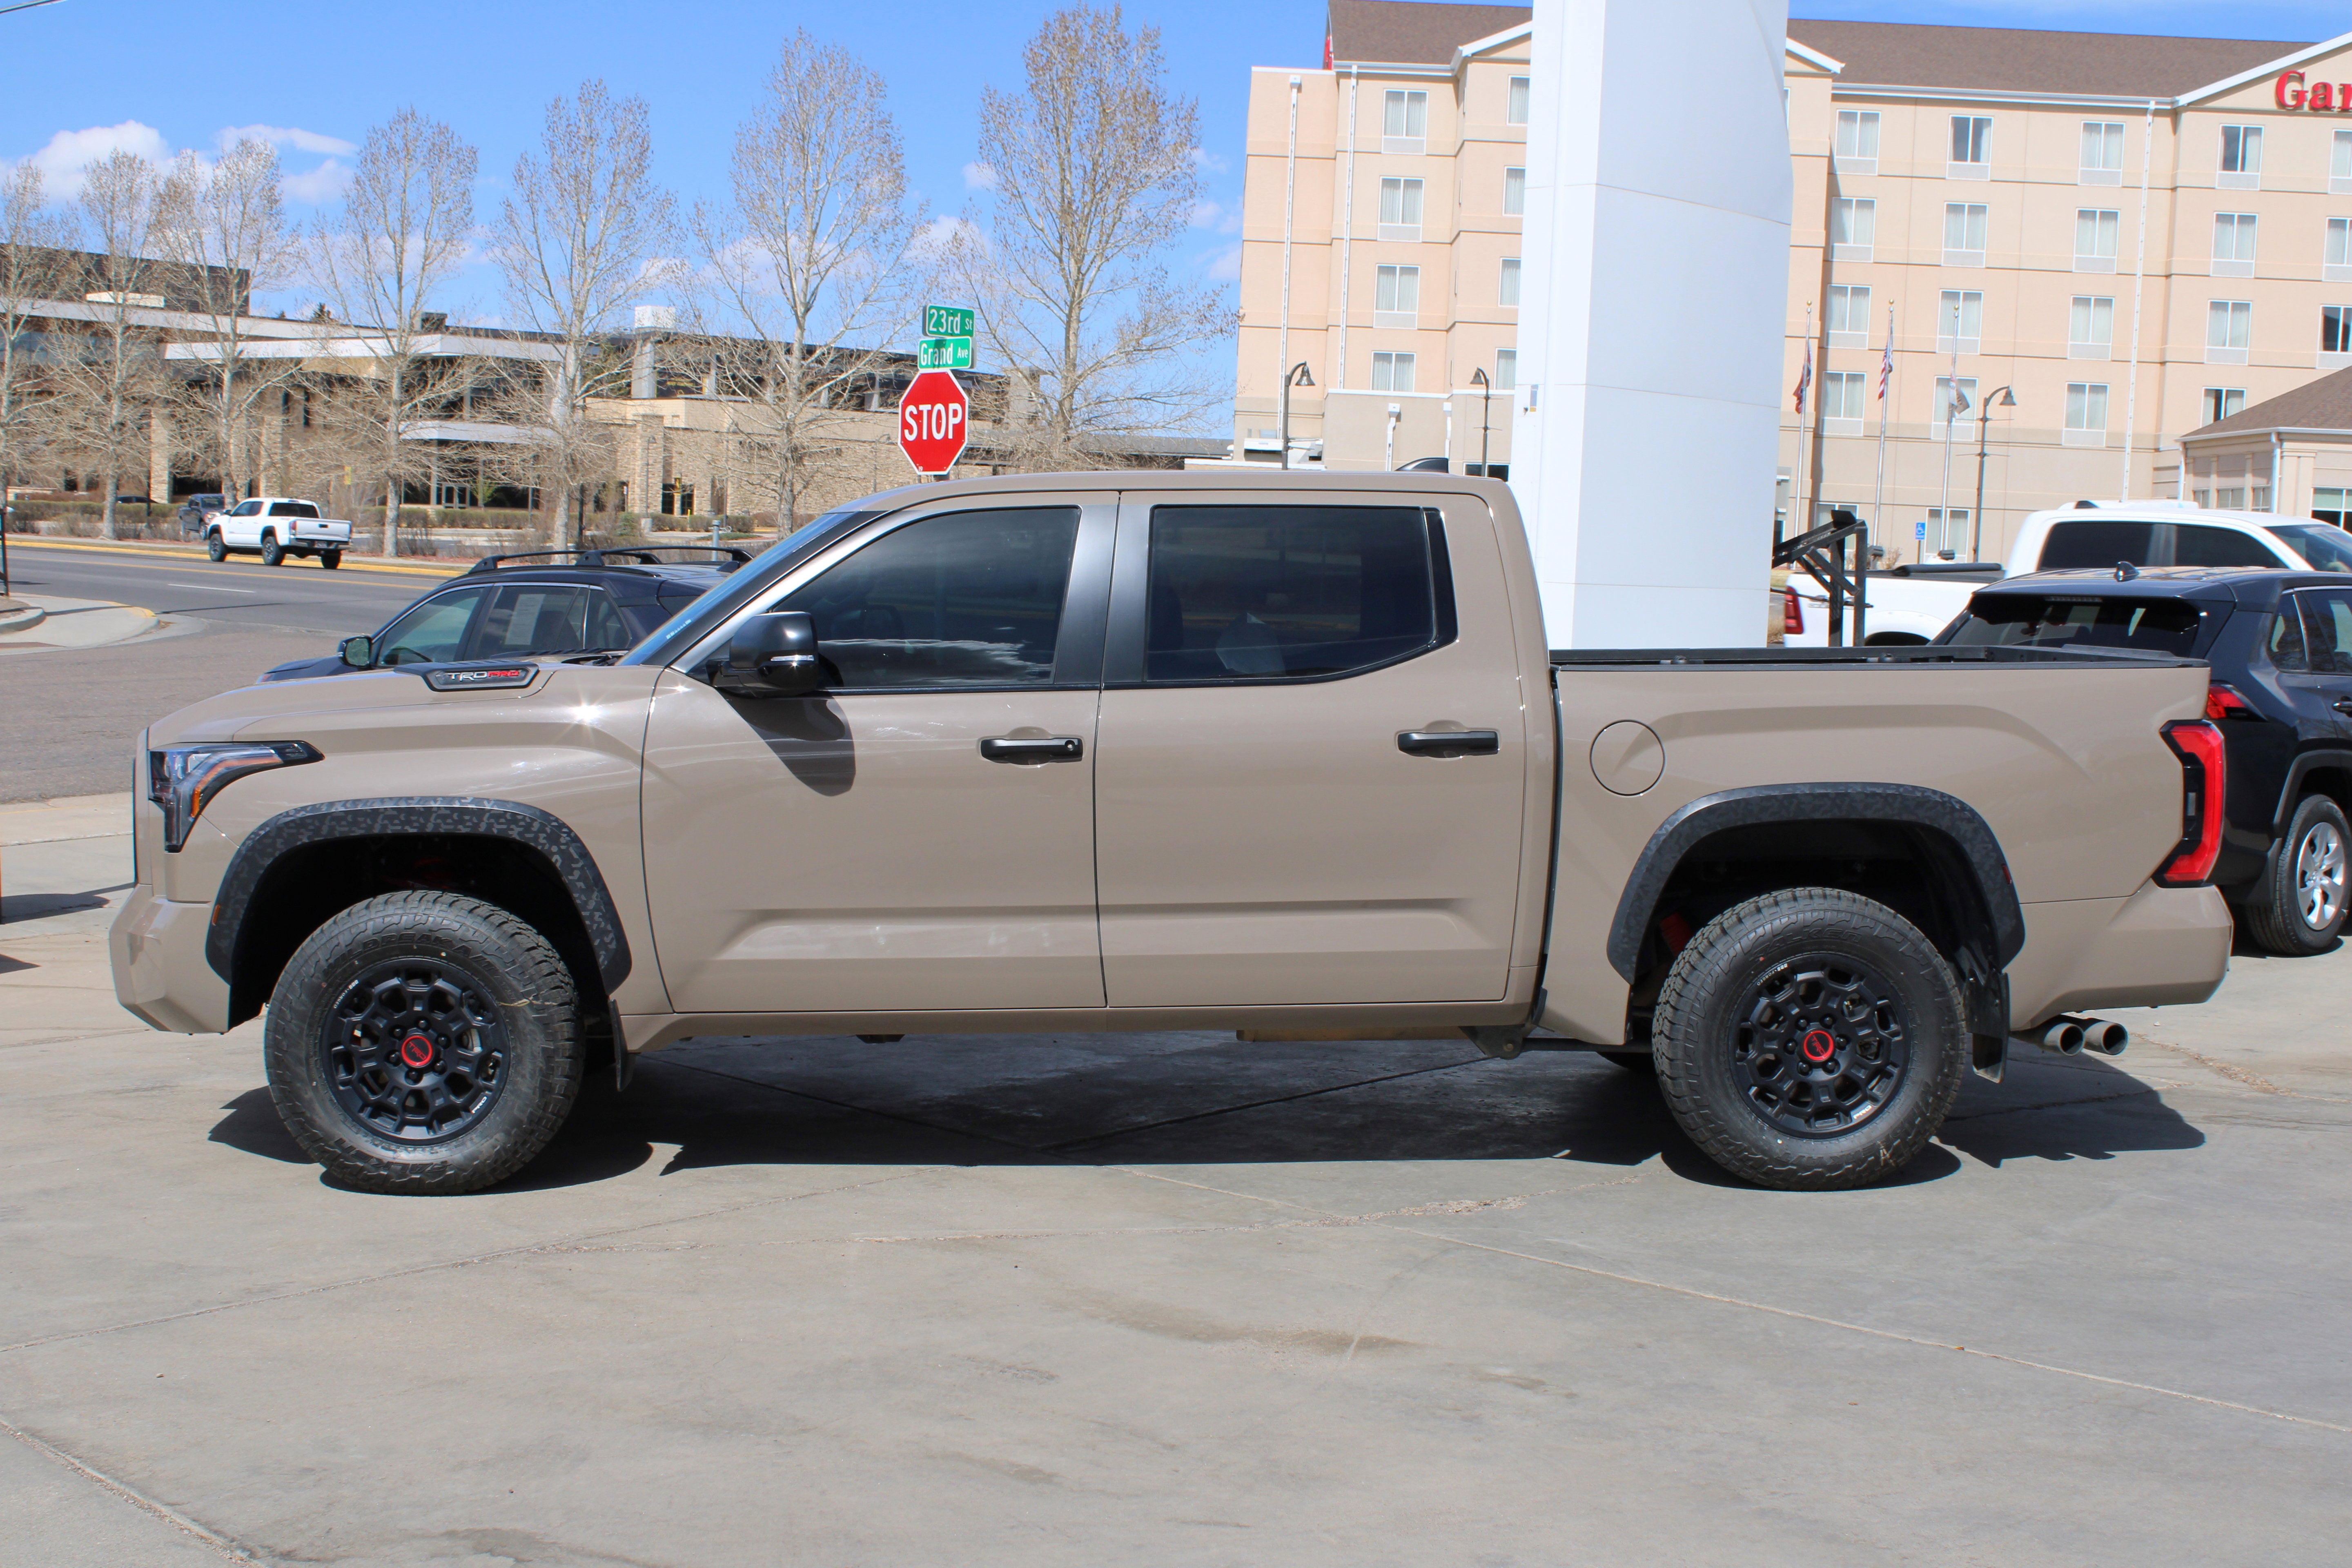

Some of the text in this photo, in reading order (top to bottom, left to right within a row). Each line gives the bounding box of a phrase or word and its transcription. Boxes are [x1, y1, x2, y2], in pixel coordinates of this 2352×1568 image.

[929, 309, 973, 334] 23rd St
[920, 343, 968, 366] Grand Ave
[904, 403, 963, 441] STOP
[447, 671, 488, 682] TRD
